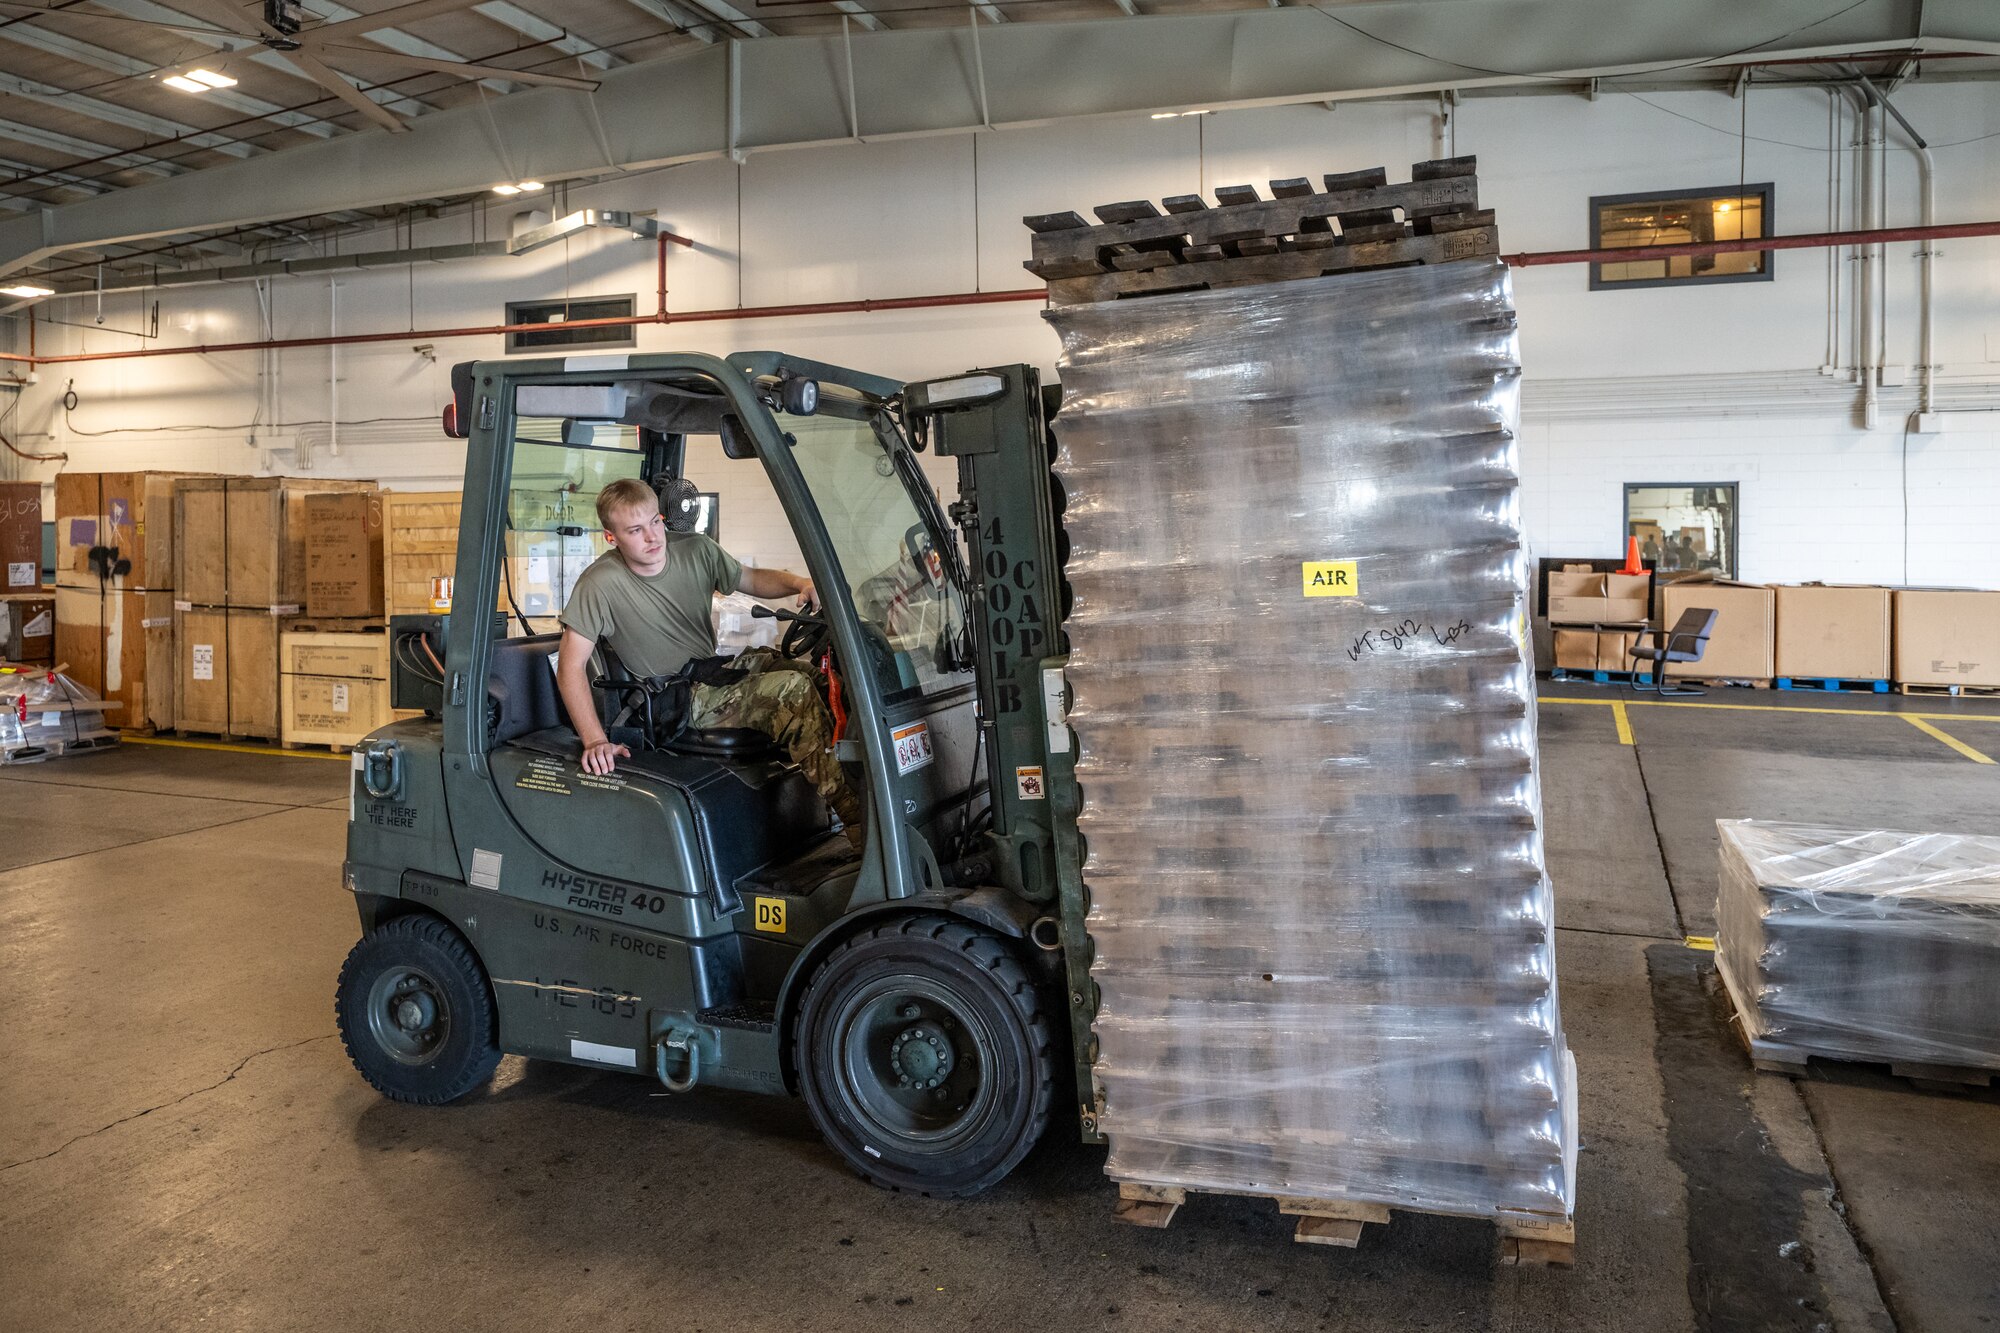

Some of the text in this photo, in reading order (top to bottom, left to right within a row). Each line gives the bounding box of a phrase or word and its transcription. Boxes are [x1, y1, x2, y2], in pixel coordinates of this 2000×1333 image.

[545, 505, 575, 522] DOOR
[1312, 570, 1348, 586] AIR
[1013, 560, 1043, 658] CAP
[1380, 619, 1422, 650] 842
[365, 804, 418, 819] LIFT HERE
[368, 814, 414, 828] TIE HERE
[542, 869, 666, 914] HYSTER 40
[567, 896, 624, 915] FORTIS
[759, 904, 782, 926] DS
[534, 914, 667, 960] U.S. AIR FORCE
